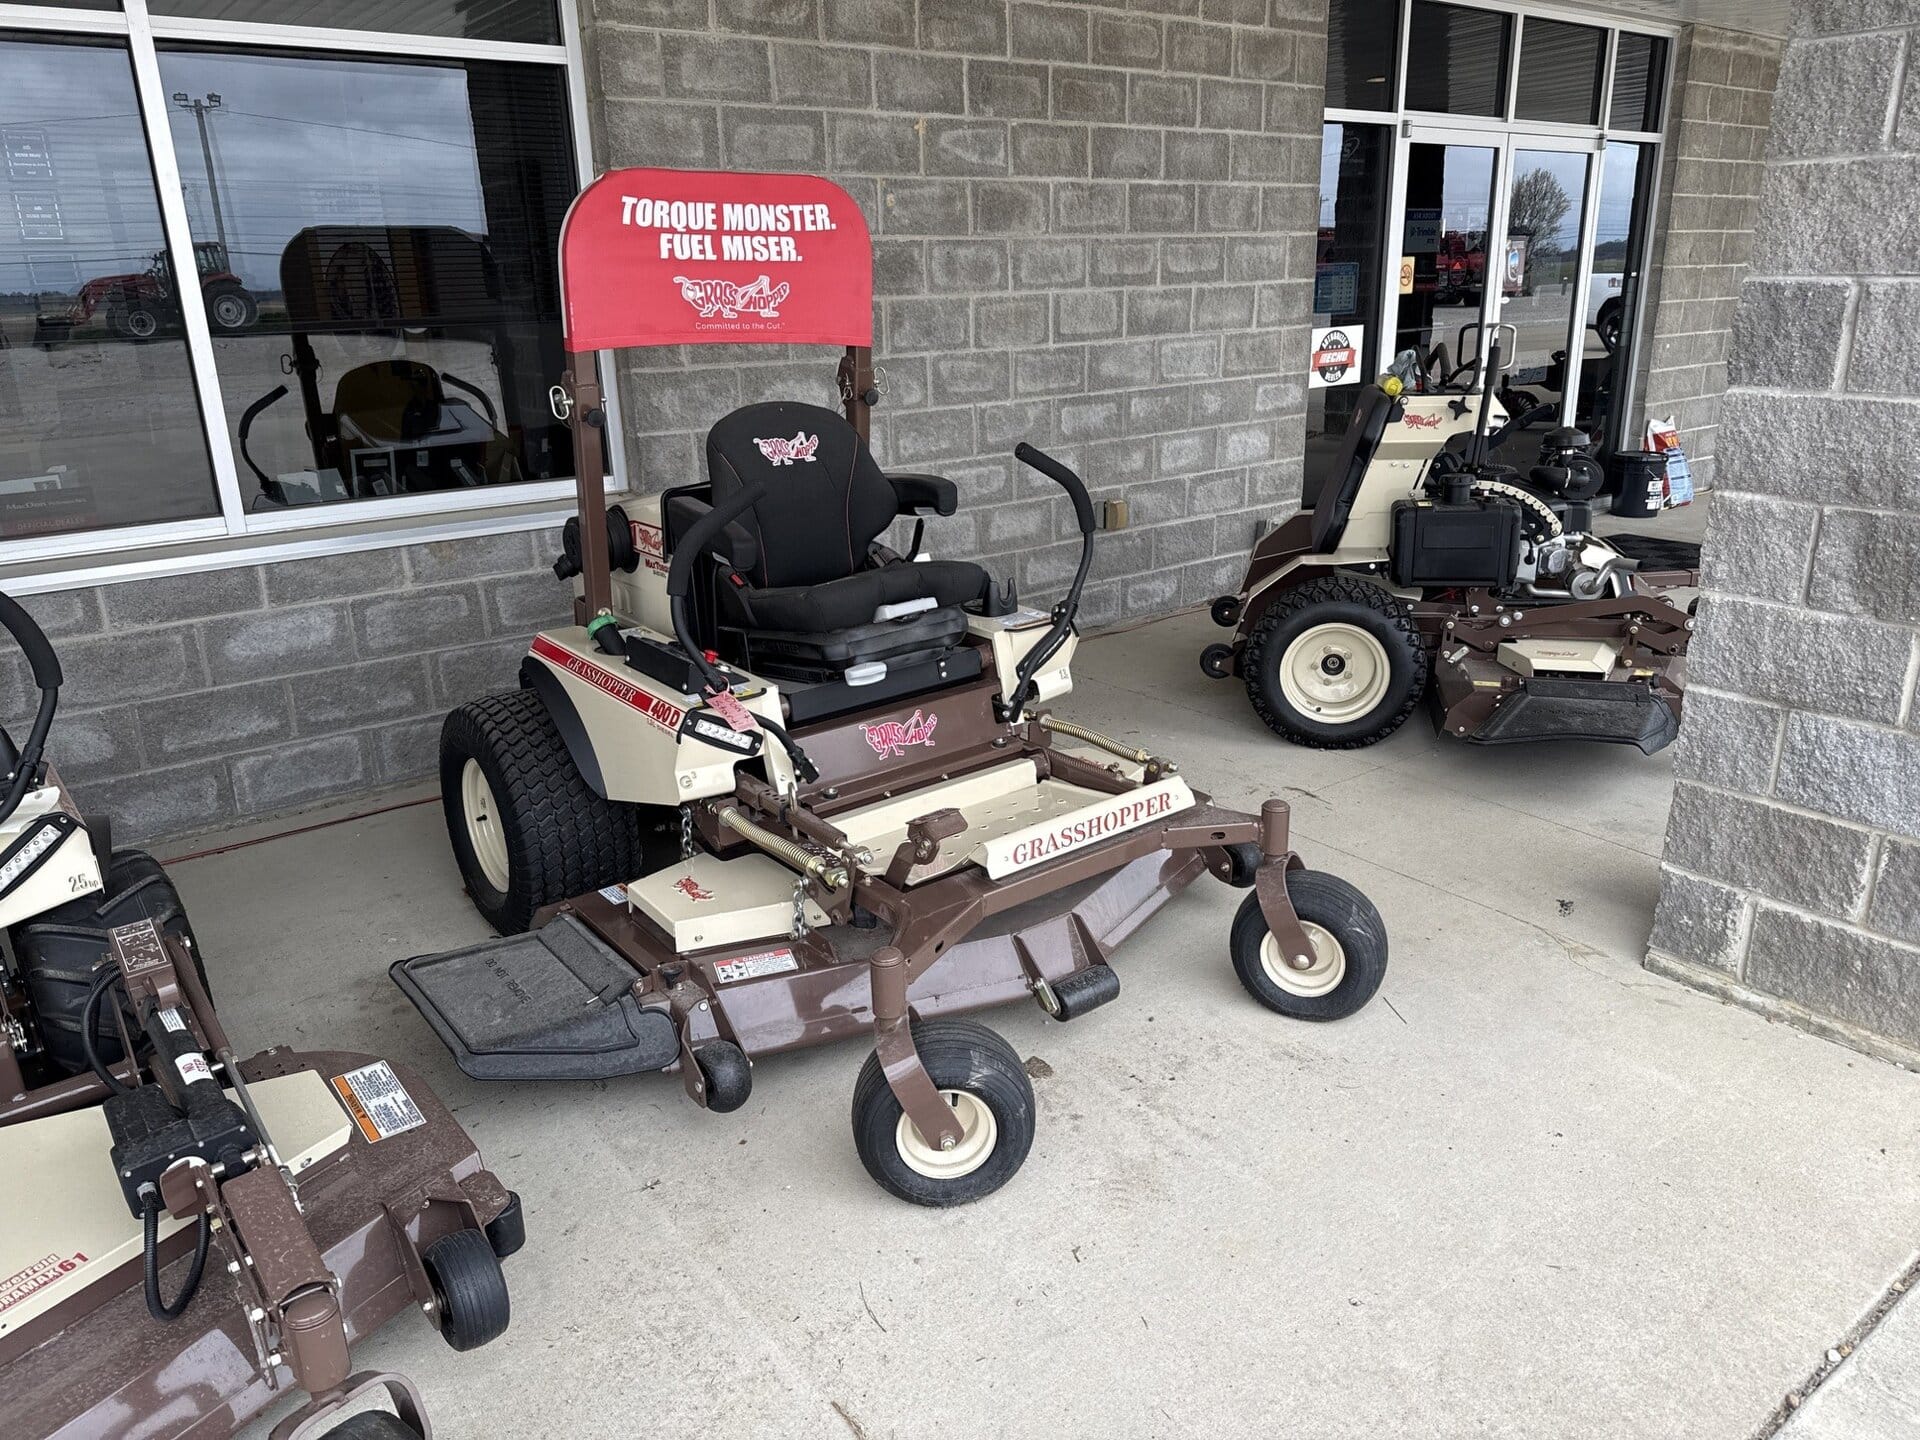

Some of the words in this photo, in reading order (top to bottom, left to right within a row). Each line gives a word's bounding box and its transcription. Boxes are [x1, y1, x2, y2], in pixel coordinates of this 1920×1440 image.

[621, 195, 717, 231] TORQUE
[723, 202, 837, 232] MONSTER.
[659, 233, 717, 261] FUEL
[721, 235, 803, 262] MISER.
[695, 322, 740, 330] Committed
[752, 322, 765, 330] the
[566, 657, 637, 702] GRASSHOPPER
[1013, 792, 1173, 865] GRASSHOPPER
[485, 958, 498, 968] DO
